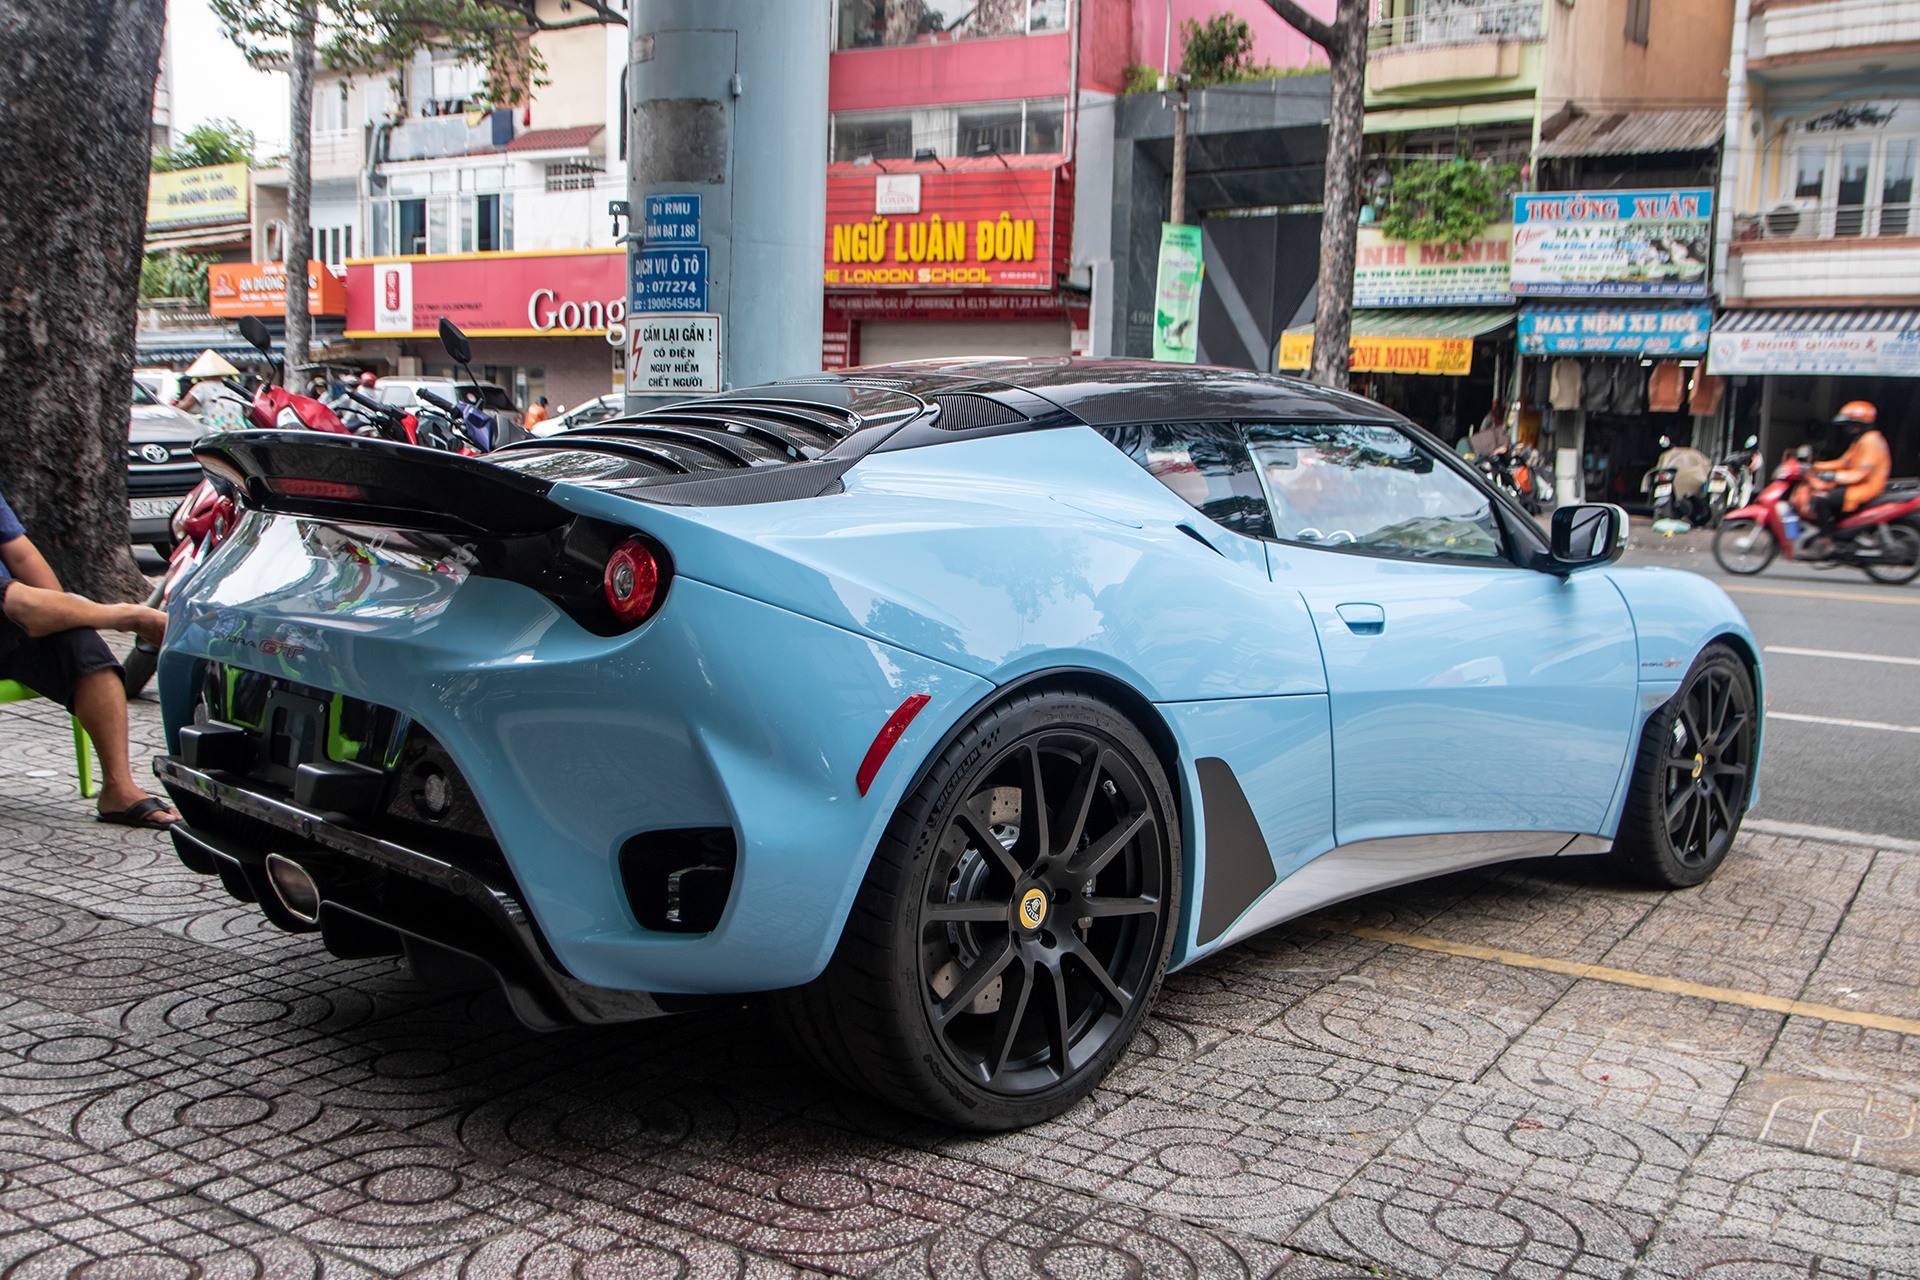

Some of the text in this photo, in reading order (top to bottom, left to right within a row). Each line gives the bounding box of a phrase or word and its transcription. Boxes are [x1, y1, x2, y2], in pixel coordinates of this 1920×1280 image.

[665, 202, 691, 215] RMU
[1633, 192, 1700, 219] XUÂN
[663, 224, 678, 240] ĐẠT
[680, 224, 696, 237] 188
[833, 211, 1035, 263] NGỮ LUÂN ĐÔN
[1556, 227, 1593, 240] MAY
[635, 254, 700, 278] DỊCH VỤ Ô TÔ
[844, 268, 915, 283] LONDON
[918, 267, 992, 284] SCHOOL
[636, 282, 645, 293] ID
[652, 281, 697, 293] 077274
[647, 297, 701, 310] 1900545454
[966, 297, 988, 309] IELTS
[989, 294, 1008, 309] NGÀY
[527, 288, 627, 346] Gong
[1534, 316, 1578, 334] MAY
[1628, 314, 1658, 332] XE
[643, 323, 660, 341] CẤM
[663, 328, 679, 344] LẠI
[682, 322, 704, 341] GẦN
[653, 346, 695, 359] CÓ ĐIỆN
[1385, 347, 1430, 368] MINH
[650, 359, 699, 373] NGUY HIỂM
[648, 374, 703, 387] CHẾT NGƯỜI
[258, 639, 305, 658] GT
[934, 745, 984, 814] MICHELIN
[1025, 900, 1040, 921] LOTUS
